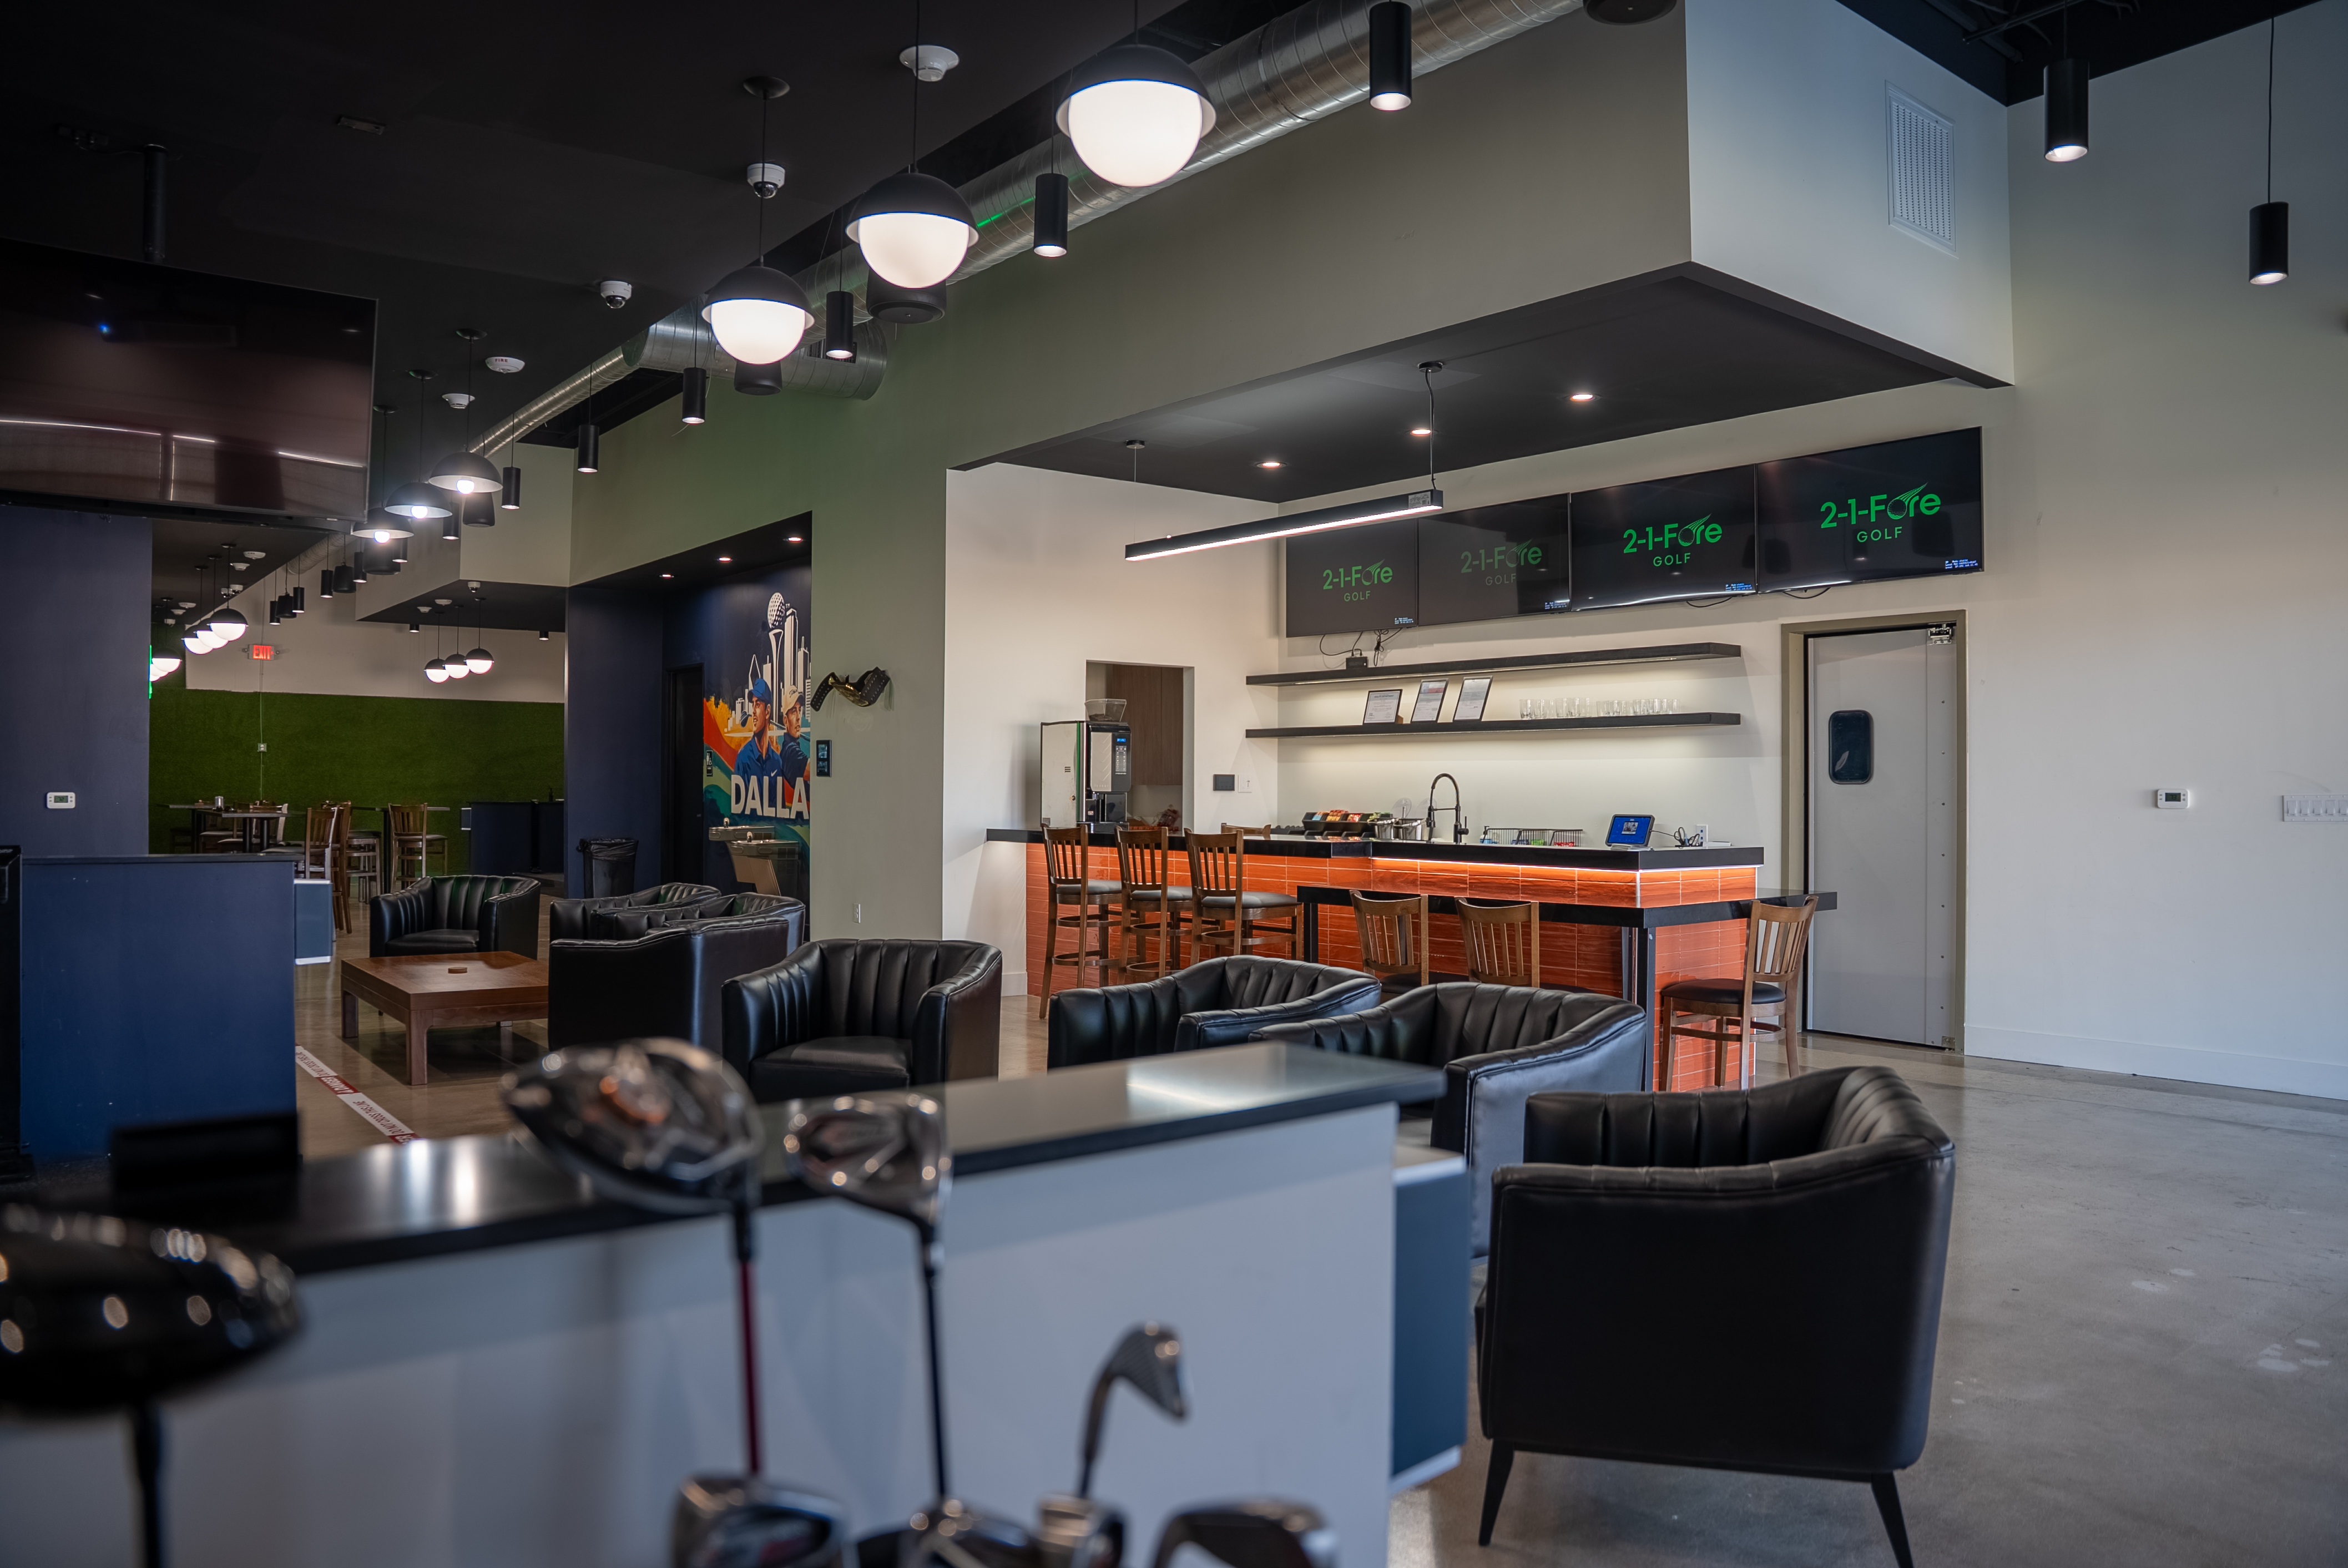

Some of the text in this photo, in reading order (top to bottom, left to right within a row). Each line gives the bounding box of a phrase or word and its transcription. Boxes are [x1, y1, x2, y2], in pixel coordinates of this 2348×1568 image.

[1820, 486, 1941, 529] 2-1-Fore
[1623, 517, 1723, 553] 2-1-Fore
[1856, 527, 1903, 543] GOLF
[1461, 543, 1542, 574] 2-1-Fore
[1653, 552, 1691, 567] GOLF
[1322, 563, 1393, 590] 2-1-Fore
[1485, 573, 1517, 586] GOLF
[1344, 590, 1371, 602] GOLF
[253, 645, 271, 660] EXIT
[731, 774, 809, 820] DALLA
[320, 1076, 351, 1090] DANGER
[368, 1112, 390, 1123] CROSS
